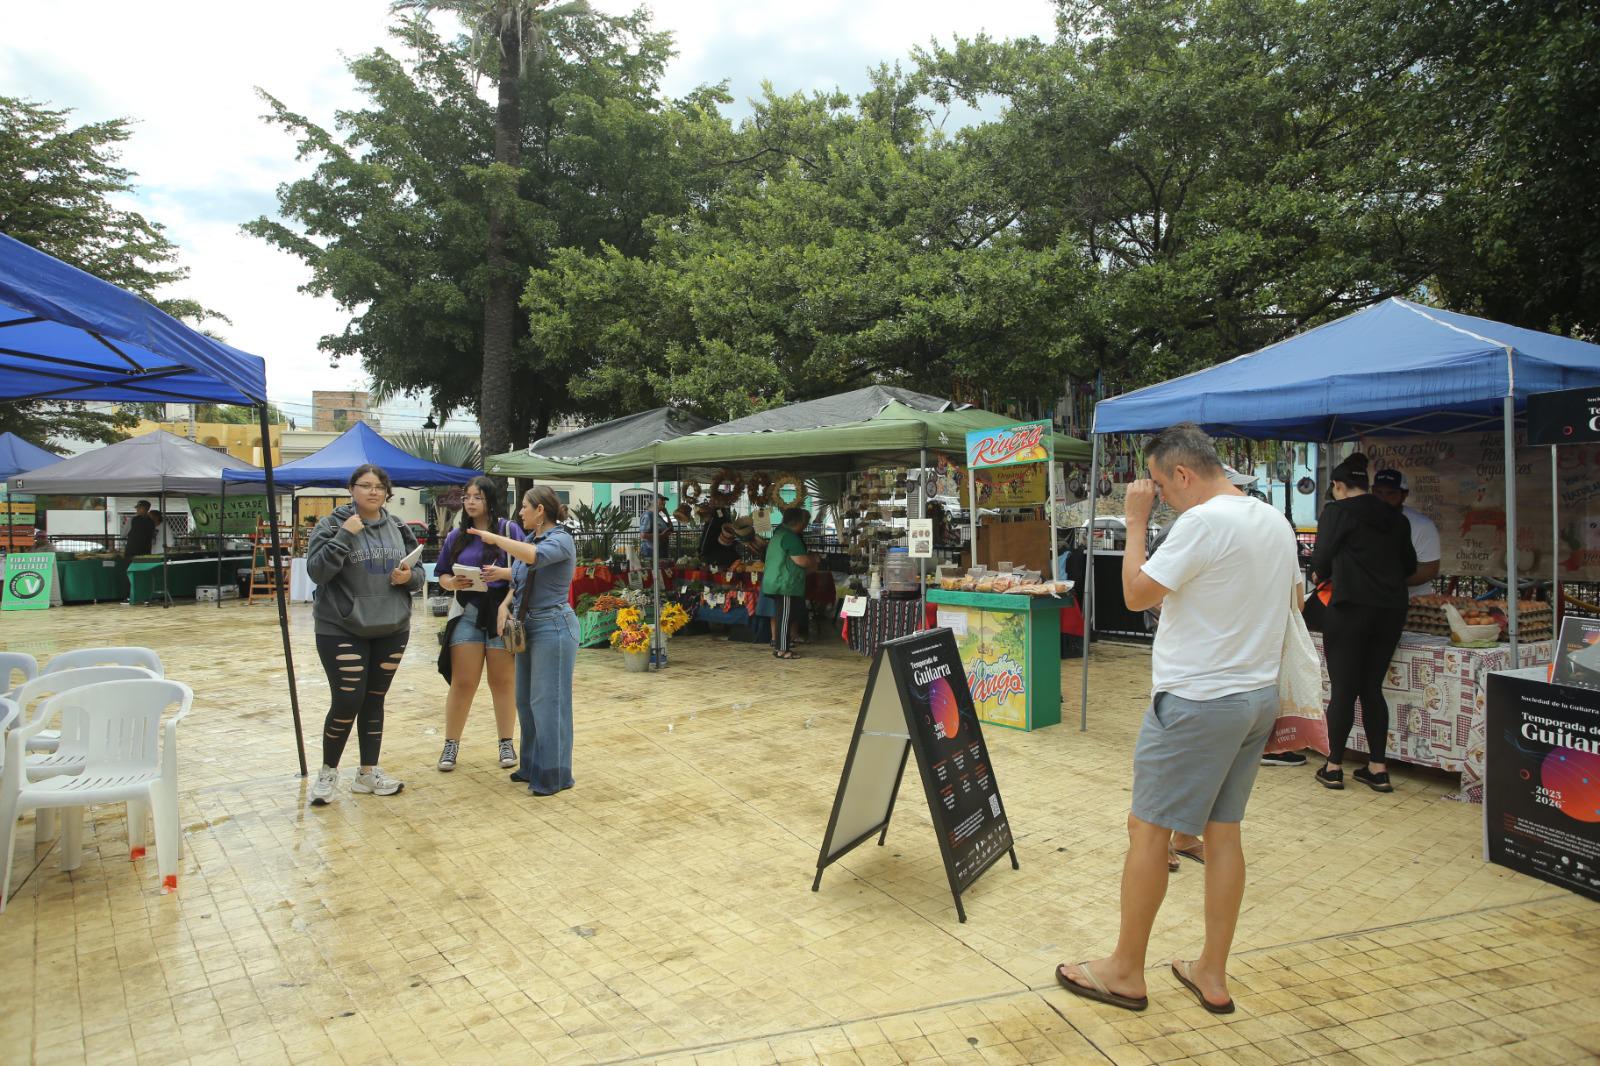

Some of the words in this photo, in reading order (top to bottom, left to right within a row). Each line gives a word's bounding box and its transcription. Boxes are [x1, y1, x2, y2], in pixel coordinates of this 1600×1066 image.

[971, 425, 1043, 466] Rivera
[1367, 442, 1408, 459] Queso
[1410, 439, 1449, 456] estilo
[1374, 456, 1436, 471] Oaxaca
[203, 501, 223, 510] VID
[229, 500, 263, 509] VERDE
[1463, 538, 1483, 550] The
[1456, 550, 1489, 561] chicken
[1461, 561, 1484, 571] Store
[913, 663, 952, 687] Guitarra
[1521, 695, 1550, 706] Sociedad
[1569, 704, 1600, 715] Guitarra
[1521, 711, 1586, 733] Temporada
[1535, 794, 1562, 810] 2026
